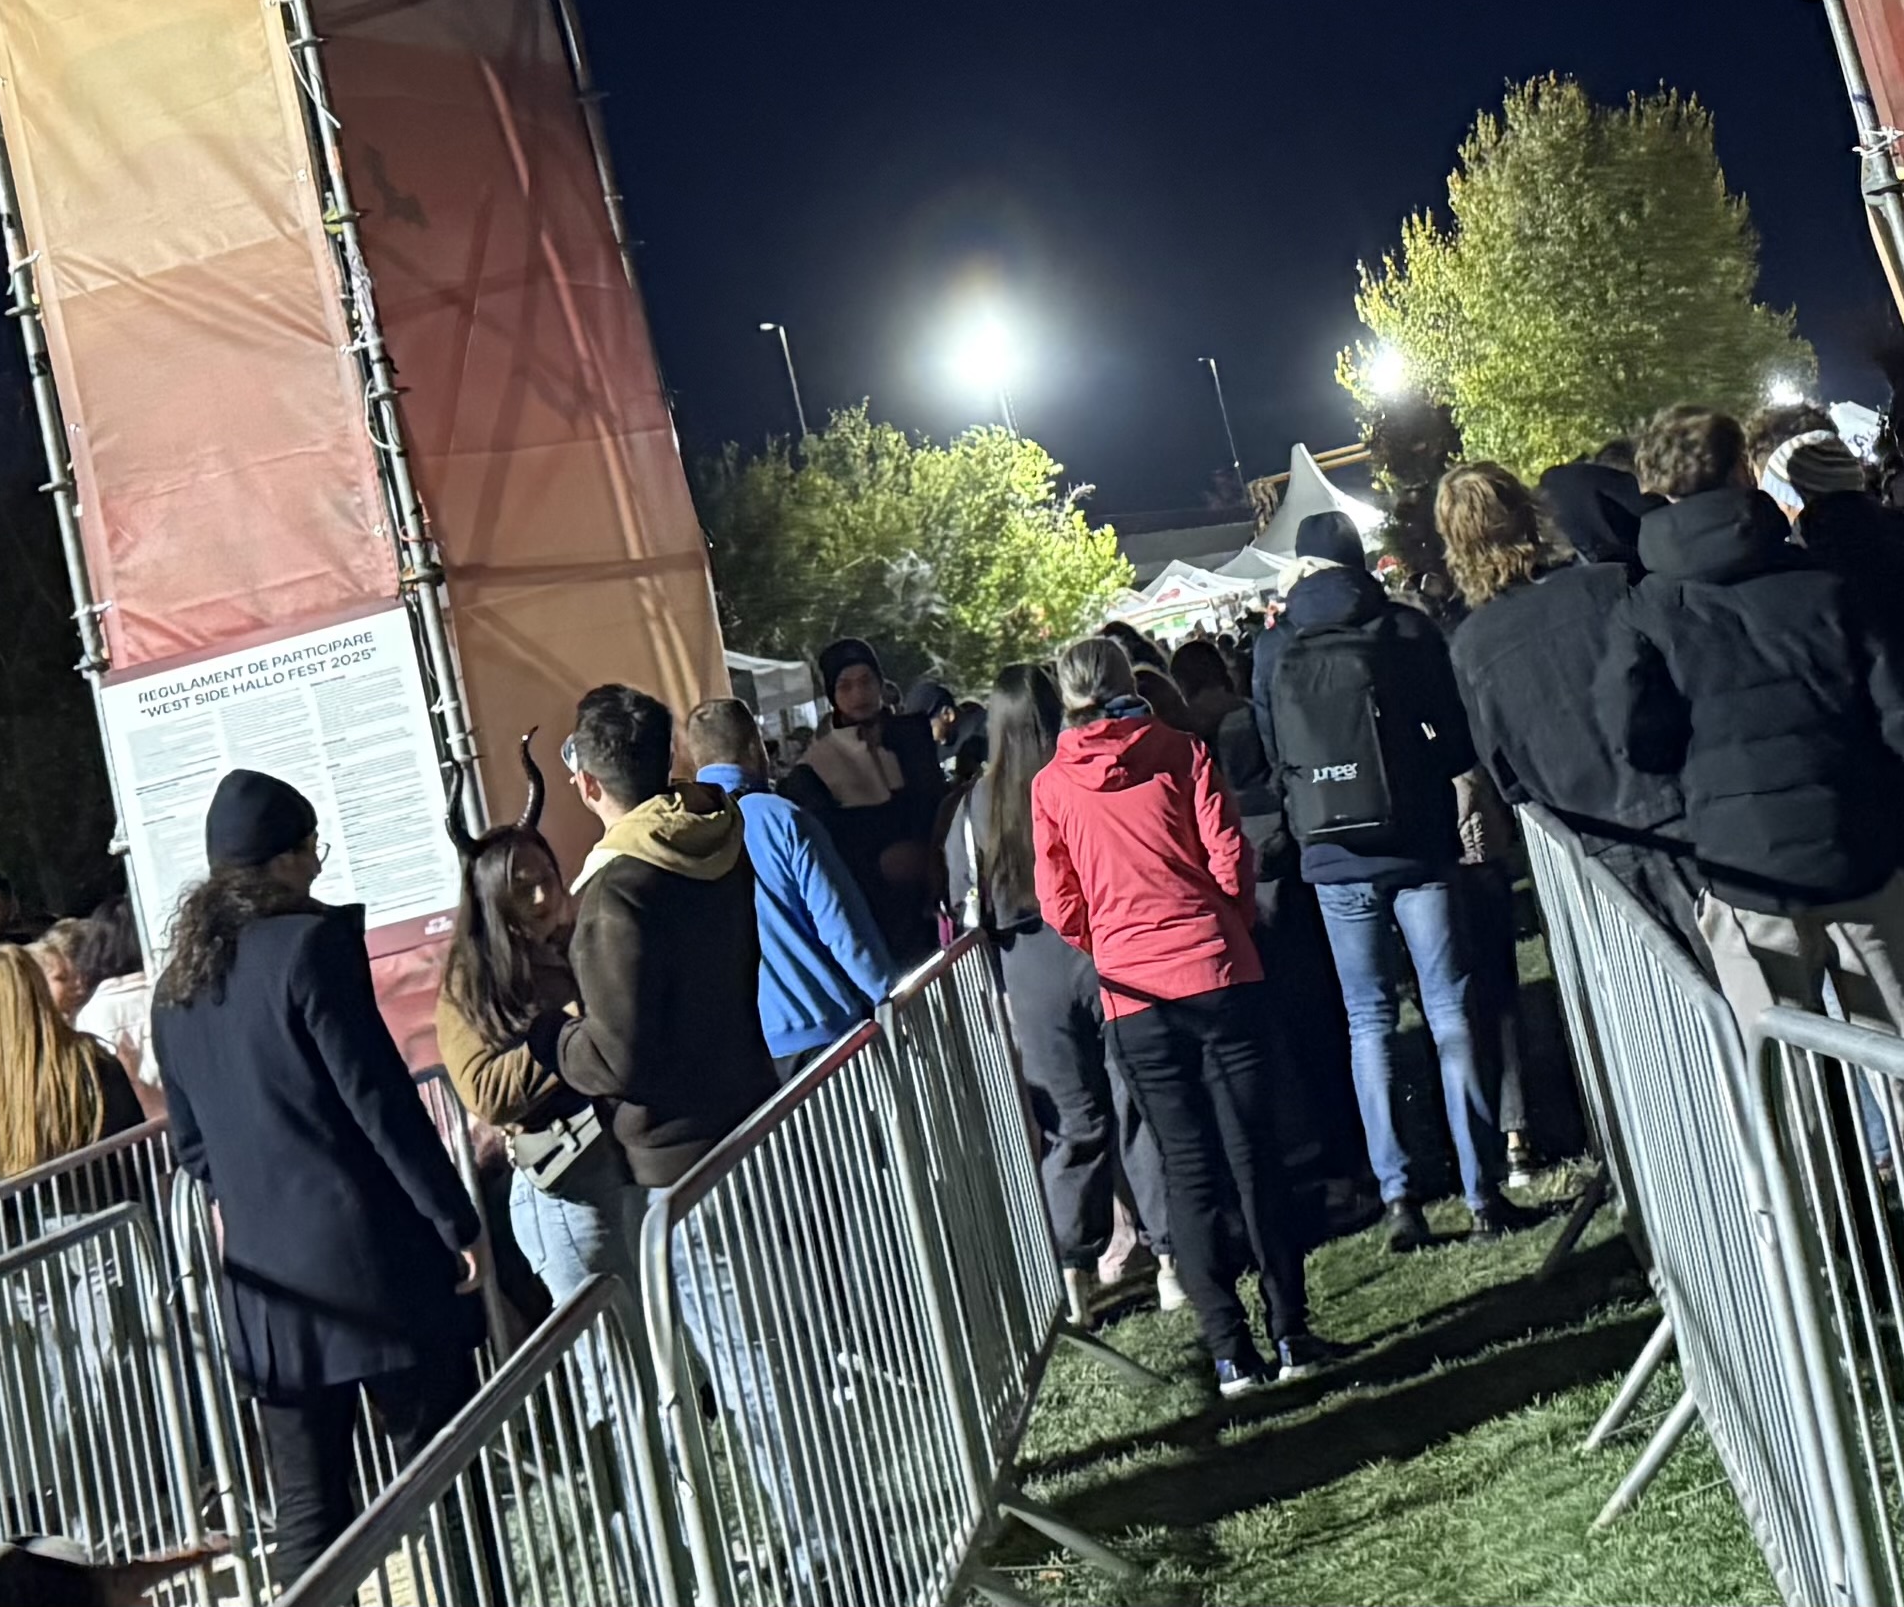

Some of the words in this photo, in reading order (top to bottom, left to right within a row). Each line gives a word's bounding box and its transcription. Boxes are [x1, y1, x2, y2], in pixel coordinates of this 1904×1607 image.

[138, 665, 244, 704] REGULAMENT
[247, 659, 269, 674] DE
[271, 631, 374, 668] PARTICIPARE
[194, 686, 231, 705] SIDE
[233, 672, 285, 695] HALLO
[287, 660, 327, 680] FEST
